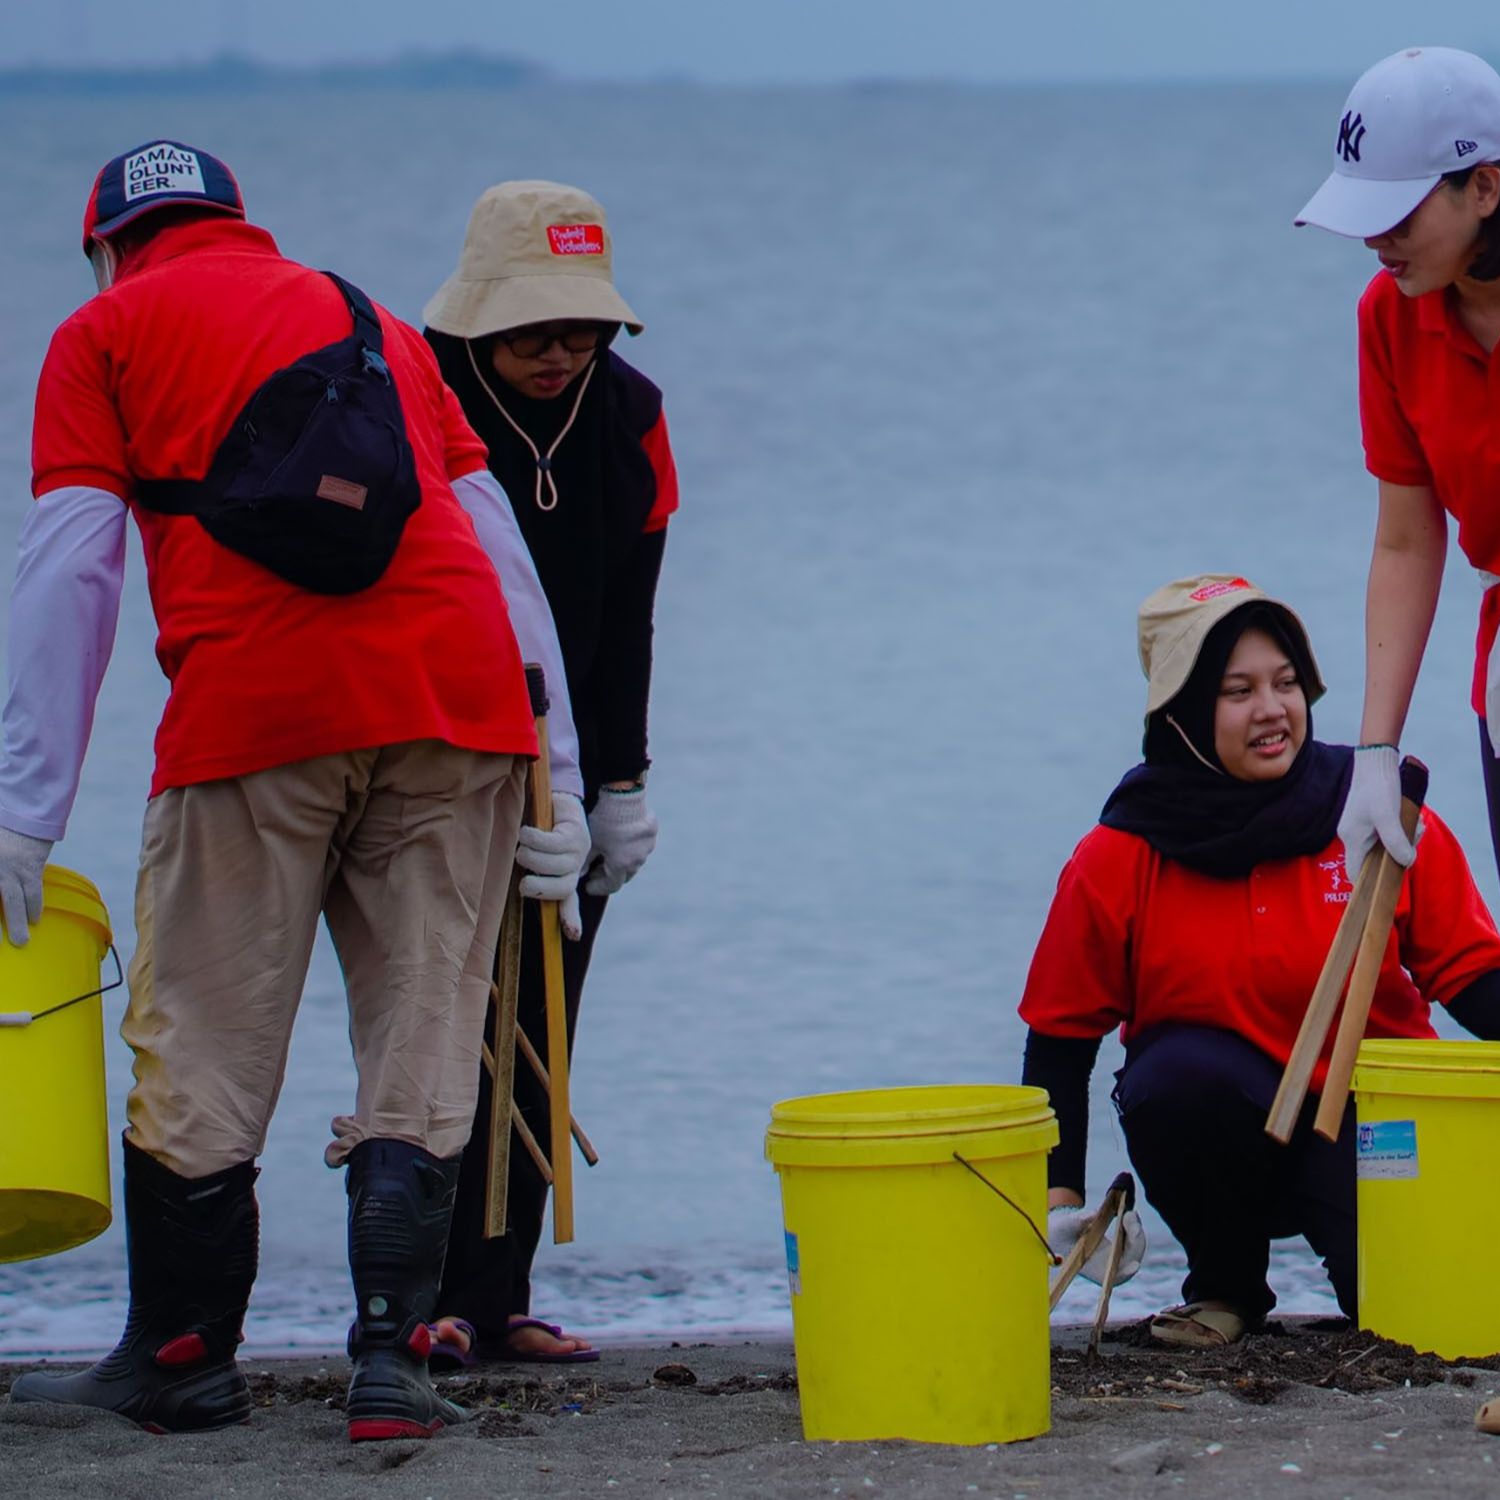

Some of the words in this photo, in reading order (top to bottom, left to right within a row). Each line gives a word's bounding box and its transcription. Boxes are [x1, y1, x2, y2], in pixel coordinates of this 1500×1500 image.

[1337, 110, 1366, 162] NY
[129, 163, 196, 181] OLUNT
[130, 177, 176, 195] EER.
